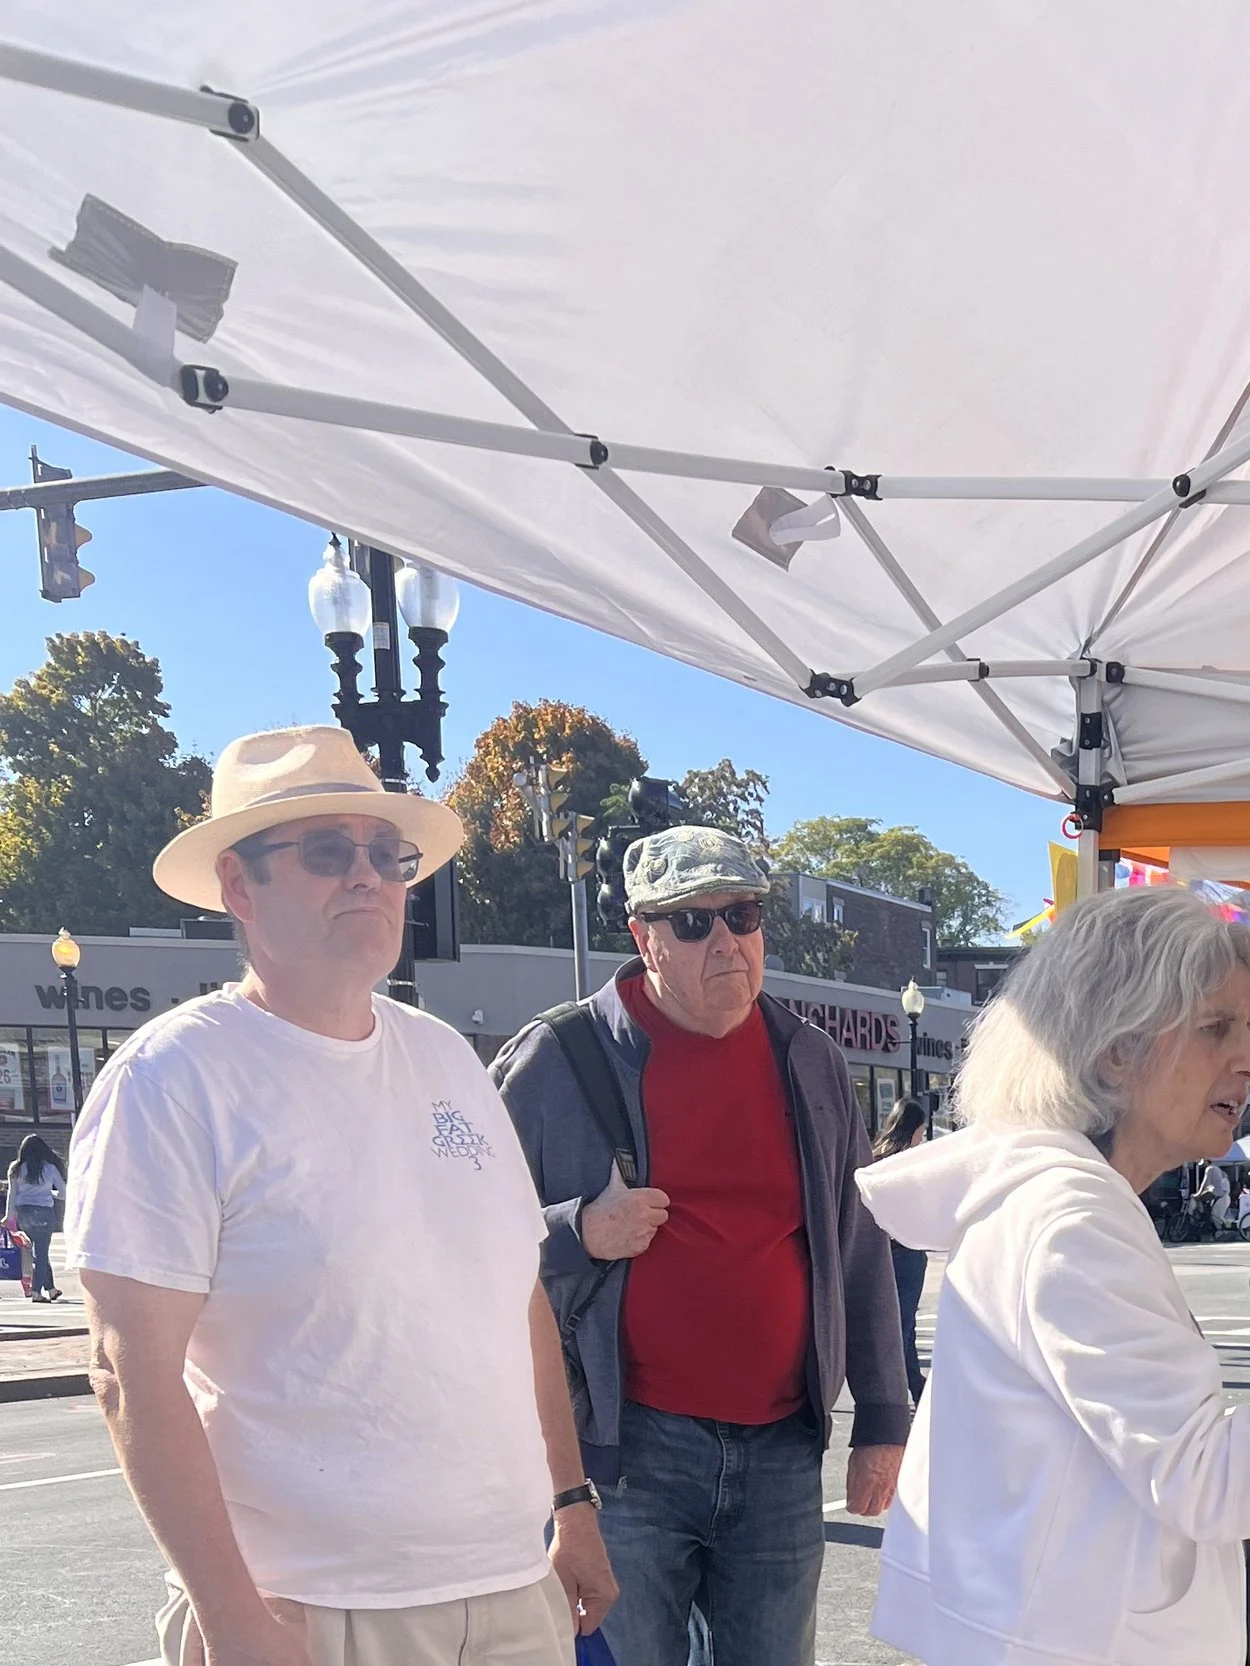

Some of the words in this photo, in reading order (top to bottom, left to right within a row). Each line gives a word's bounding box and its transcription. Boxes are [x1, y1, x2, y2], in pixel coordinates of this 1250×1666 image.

[34, 984, 151, 1011] wines
[431, 1100, 453, 1112] MY
[432, 1110, 465, 1124] BIG
[434, 1122, 473, 1135] FAT
[430, 1146, 496, 1158] WEDDING
[468, 1155, 482, 1170] 3
